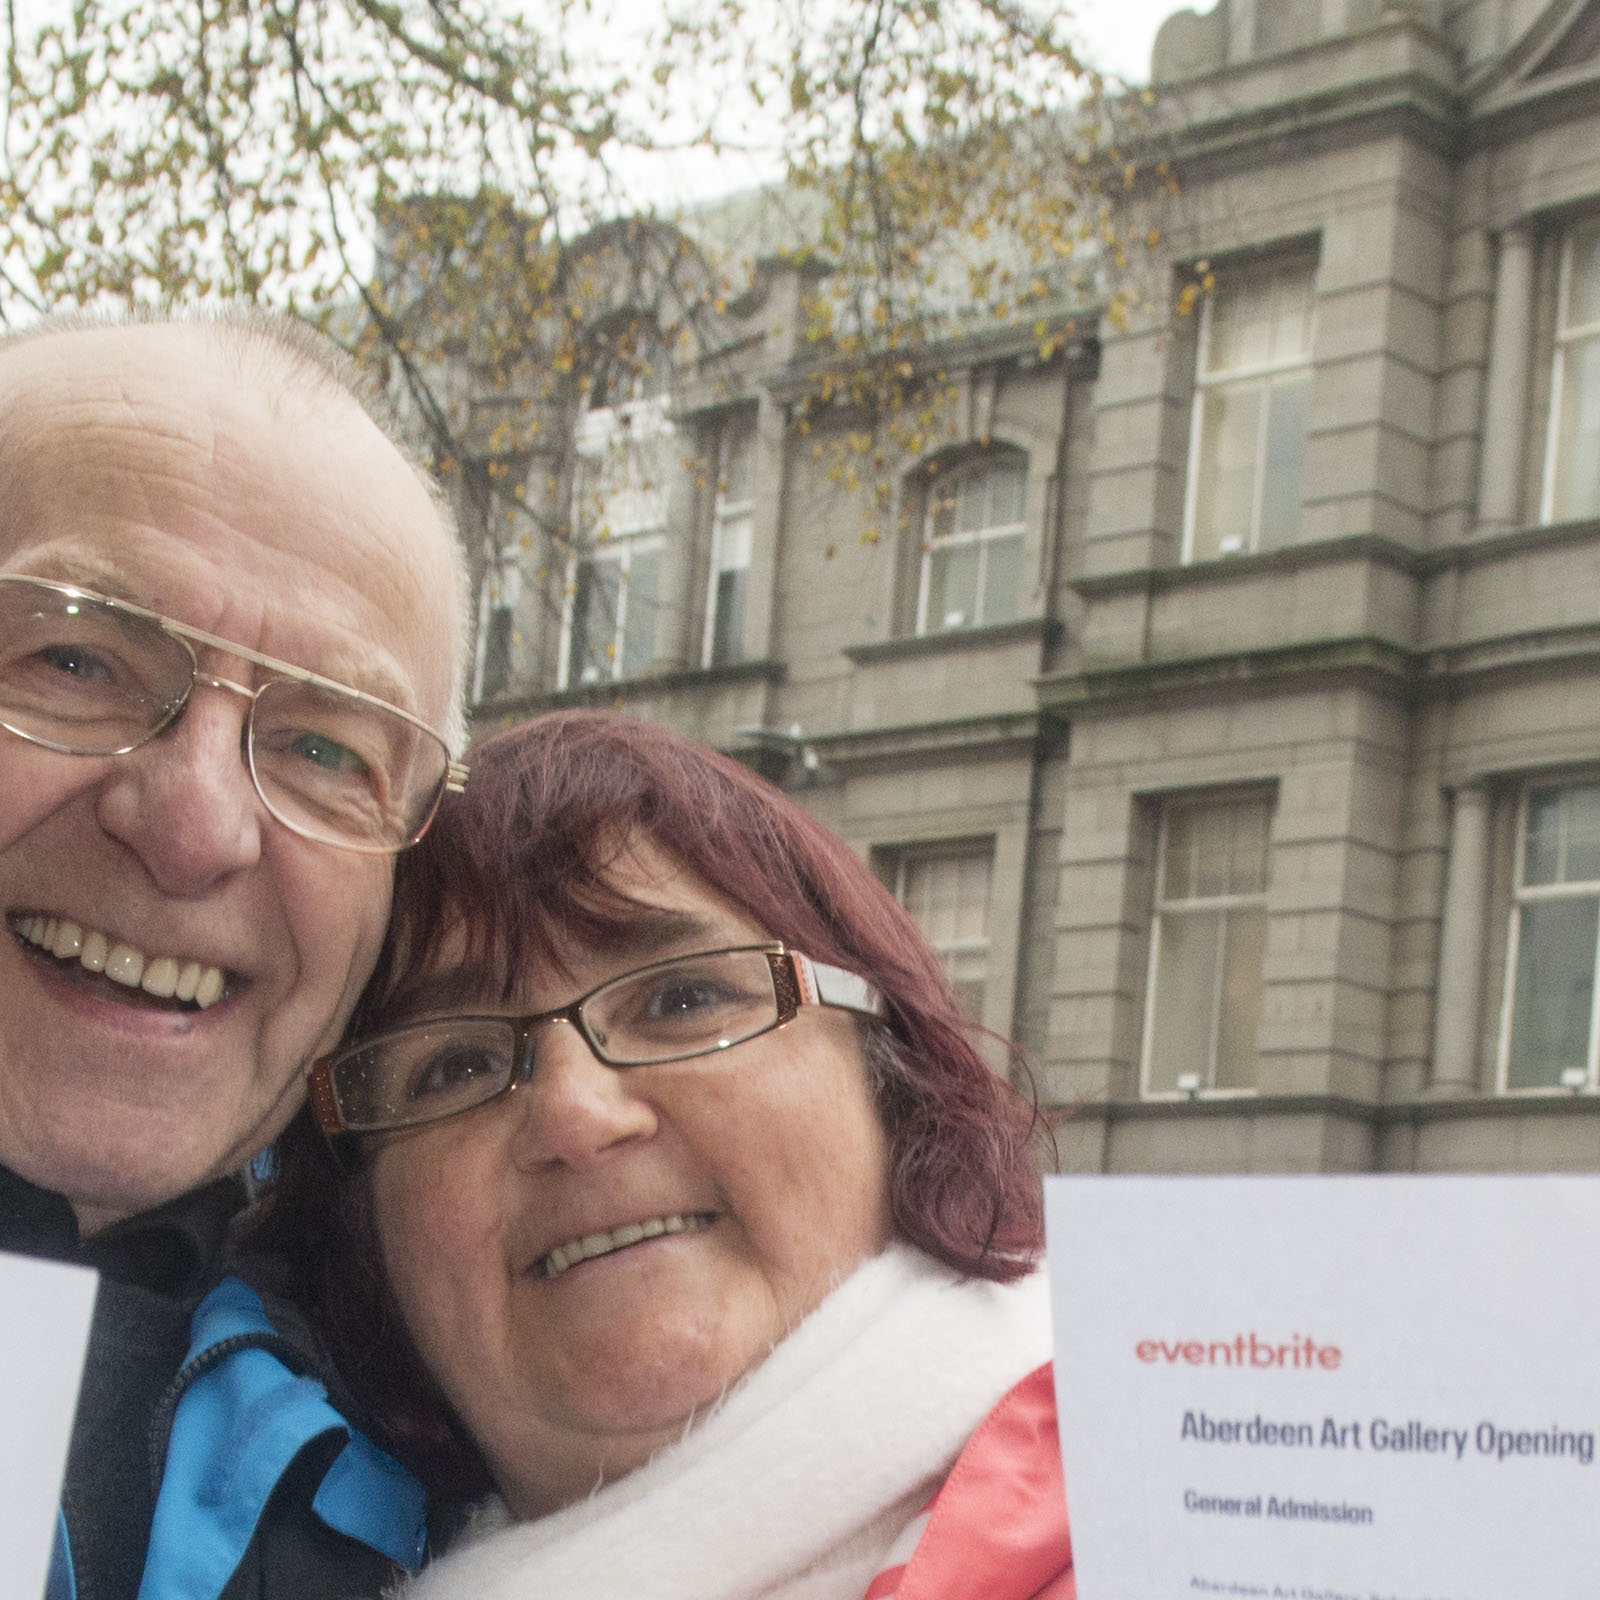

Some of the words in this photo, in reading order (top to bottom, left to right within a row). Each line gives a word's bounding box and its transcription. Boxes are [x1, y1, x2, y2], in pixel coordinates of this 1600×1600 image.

[1135, 1331, 1343, 1370] eventbrite
[1181, 1409, 1313, 1446] Aberdeen
[1320, 1417, 1362, 1450] Art
[1369, 1417, 1468, 1461] Gallery
[1475, 1422, 1595, 1465] Opening
[1184, 1489, 1262, 1517] General
[1267, 1496, 1374, 1524] Admission
[1190, 1576, 1268, 1596] Aberdeen
[1273, 1585, 1297, 1599] Art
